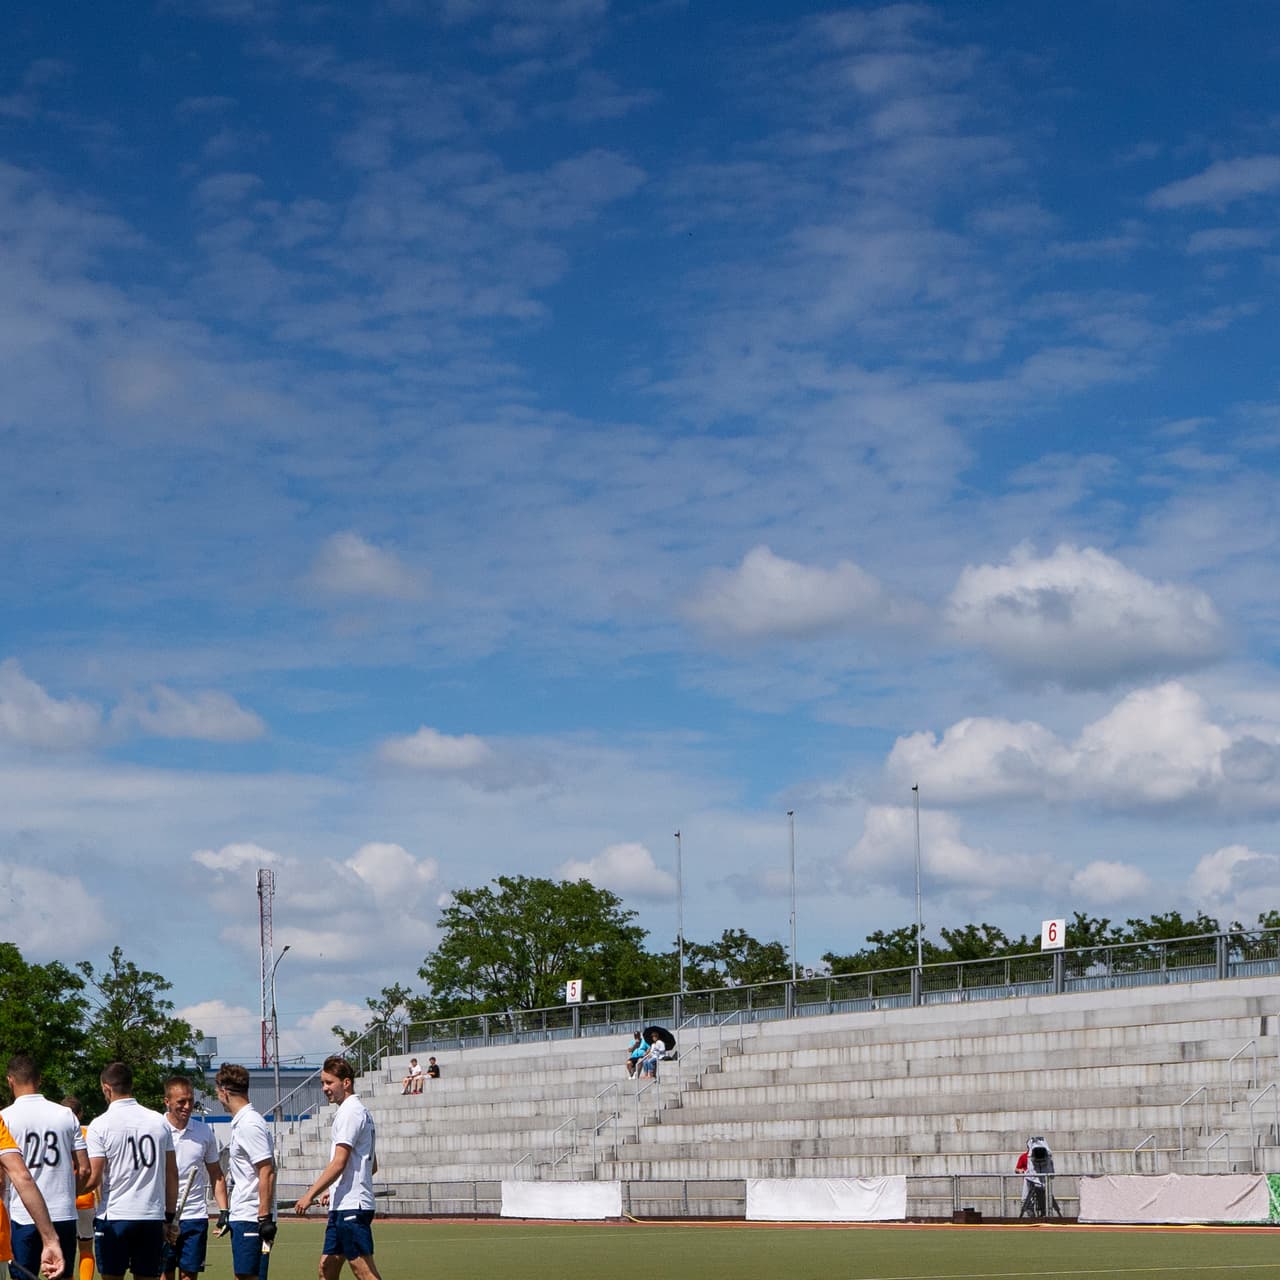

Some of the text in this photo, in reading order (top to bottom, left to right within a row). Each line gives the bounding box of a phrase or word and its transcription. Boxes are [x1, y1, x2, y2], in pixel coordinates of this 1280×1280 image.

[1048, 922, 1057, 942] 6
[570, 982, 577, 997] 5
[25, 1130, 61, 1169] 23
[127, 1133, 157, 1171] 10
